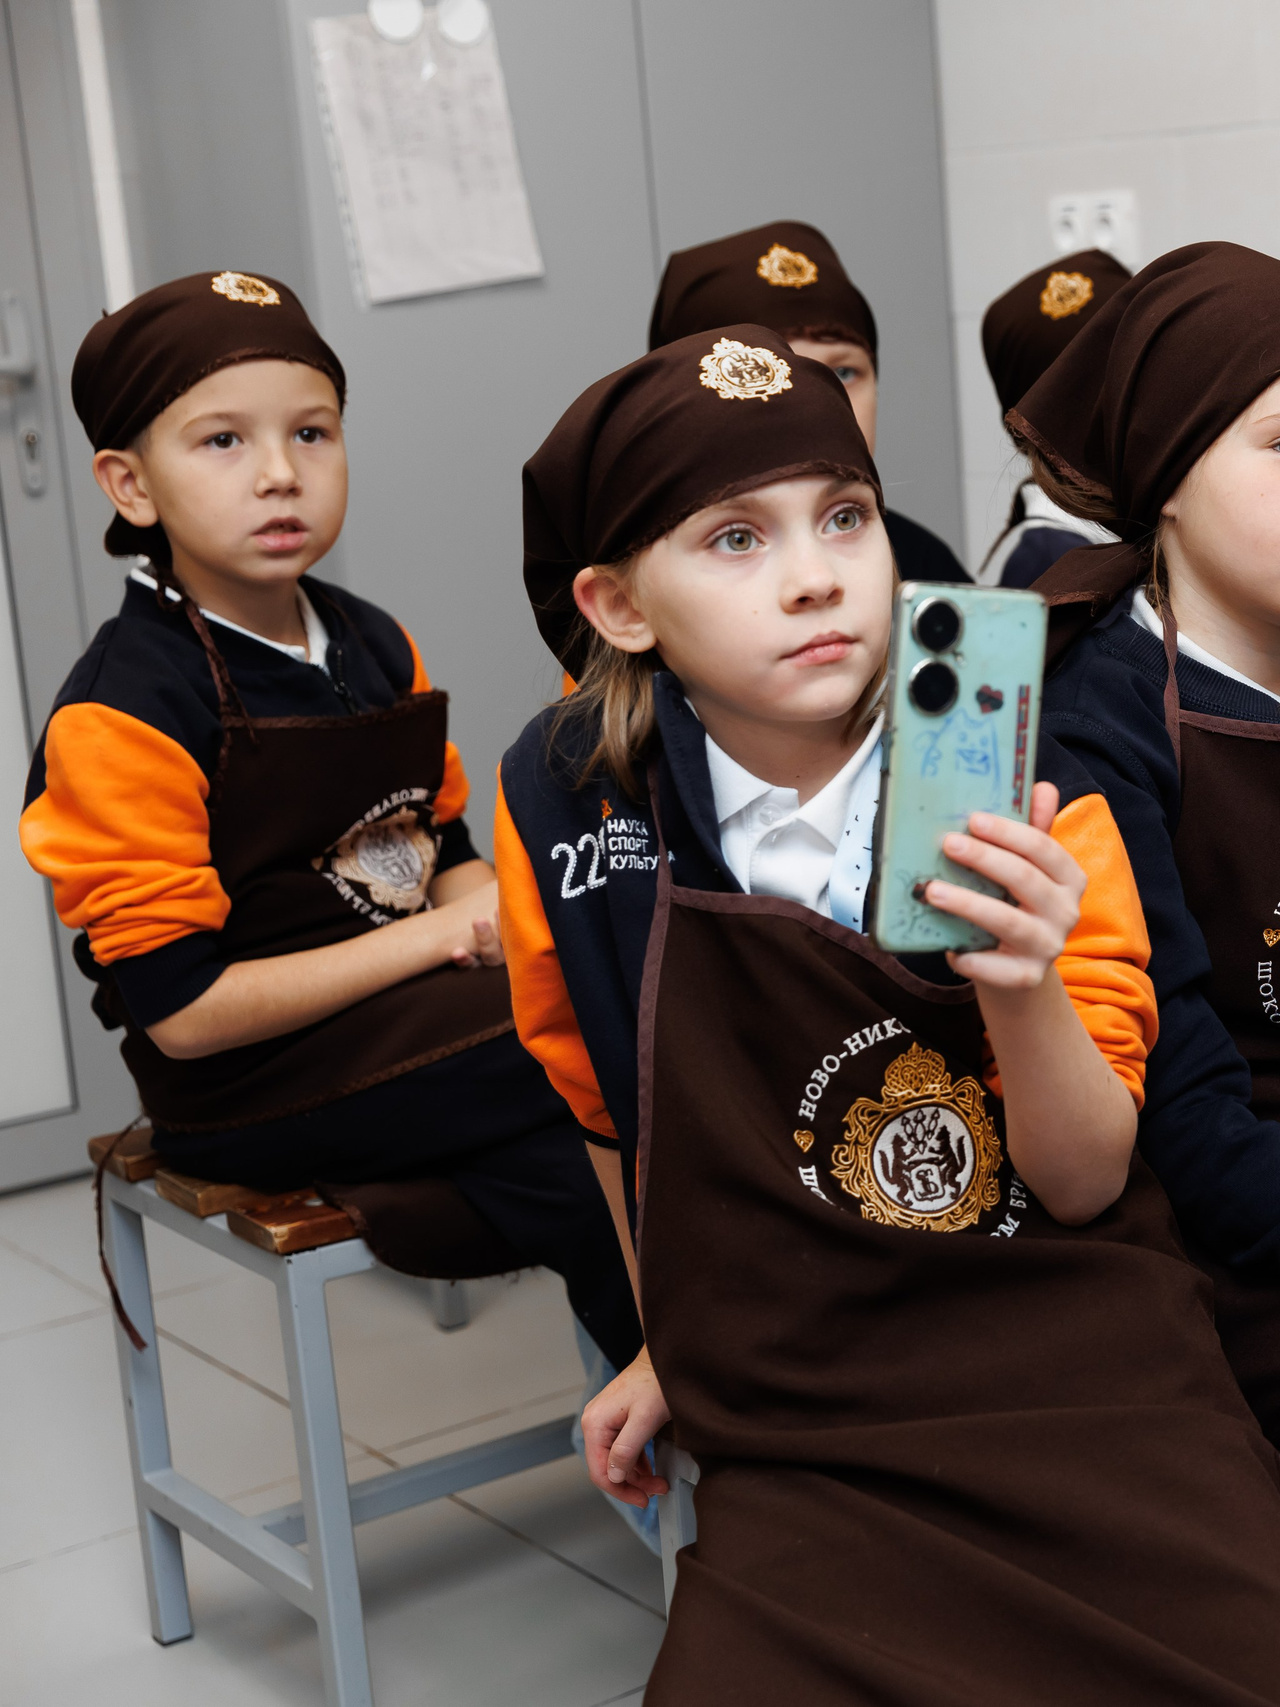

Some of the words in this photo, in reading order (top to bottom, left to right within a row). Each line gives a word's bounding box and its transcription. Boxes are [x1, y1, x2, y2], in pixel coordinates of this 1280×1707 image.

[606, 818, 649, 837] НАУКА
[607, 836, 649, 853] СПОРТ
[609, 850, 676, 871] КУЛЬТУА
